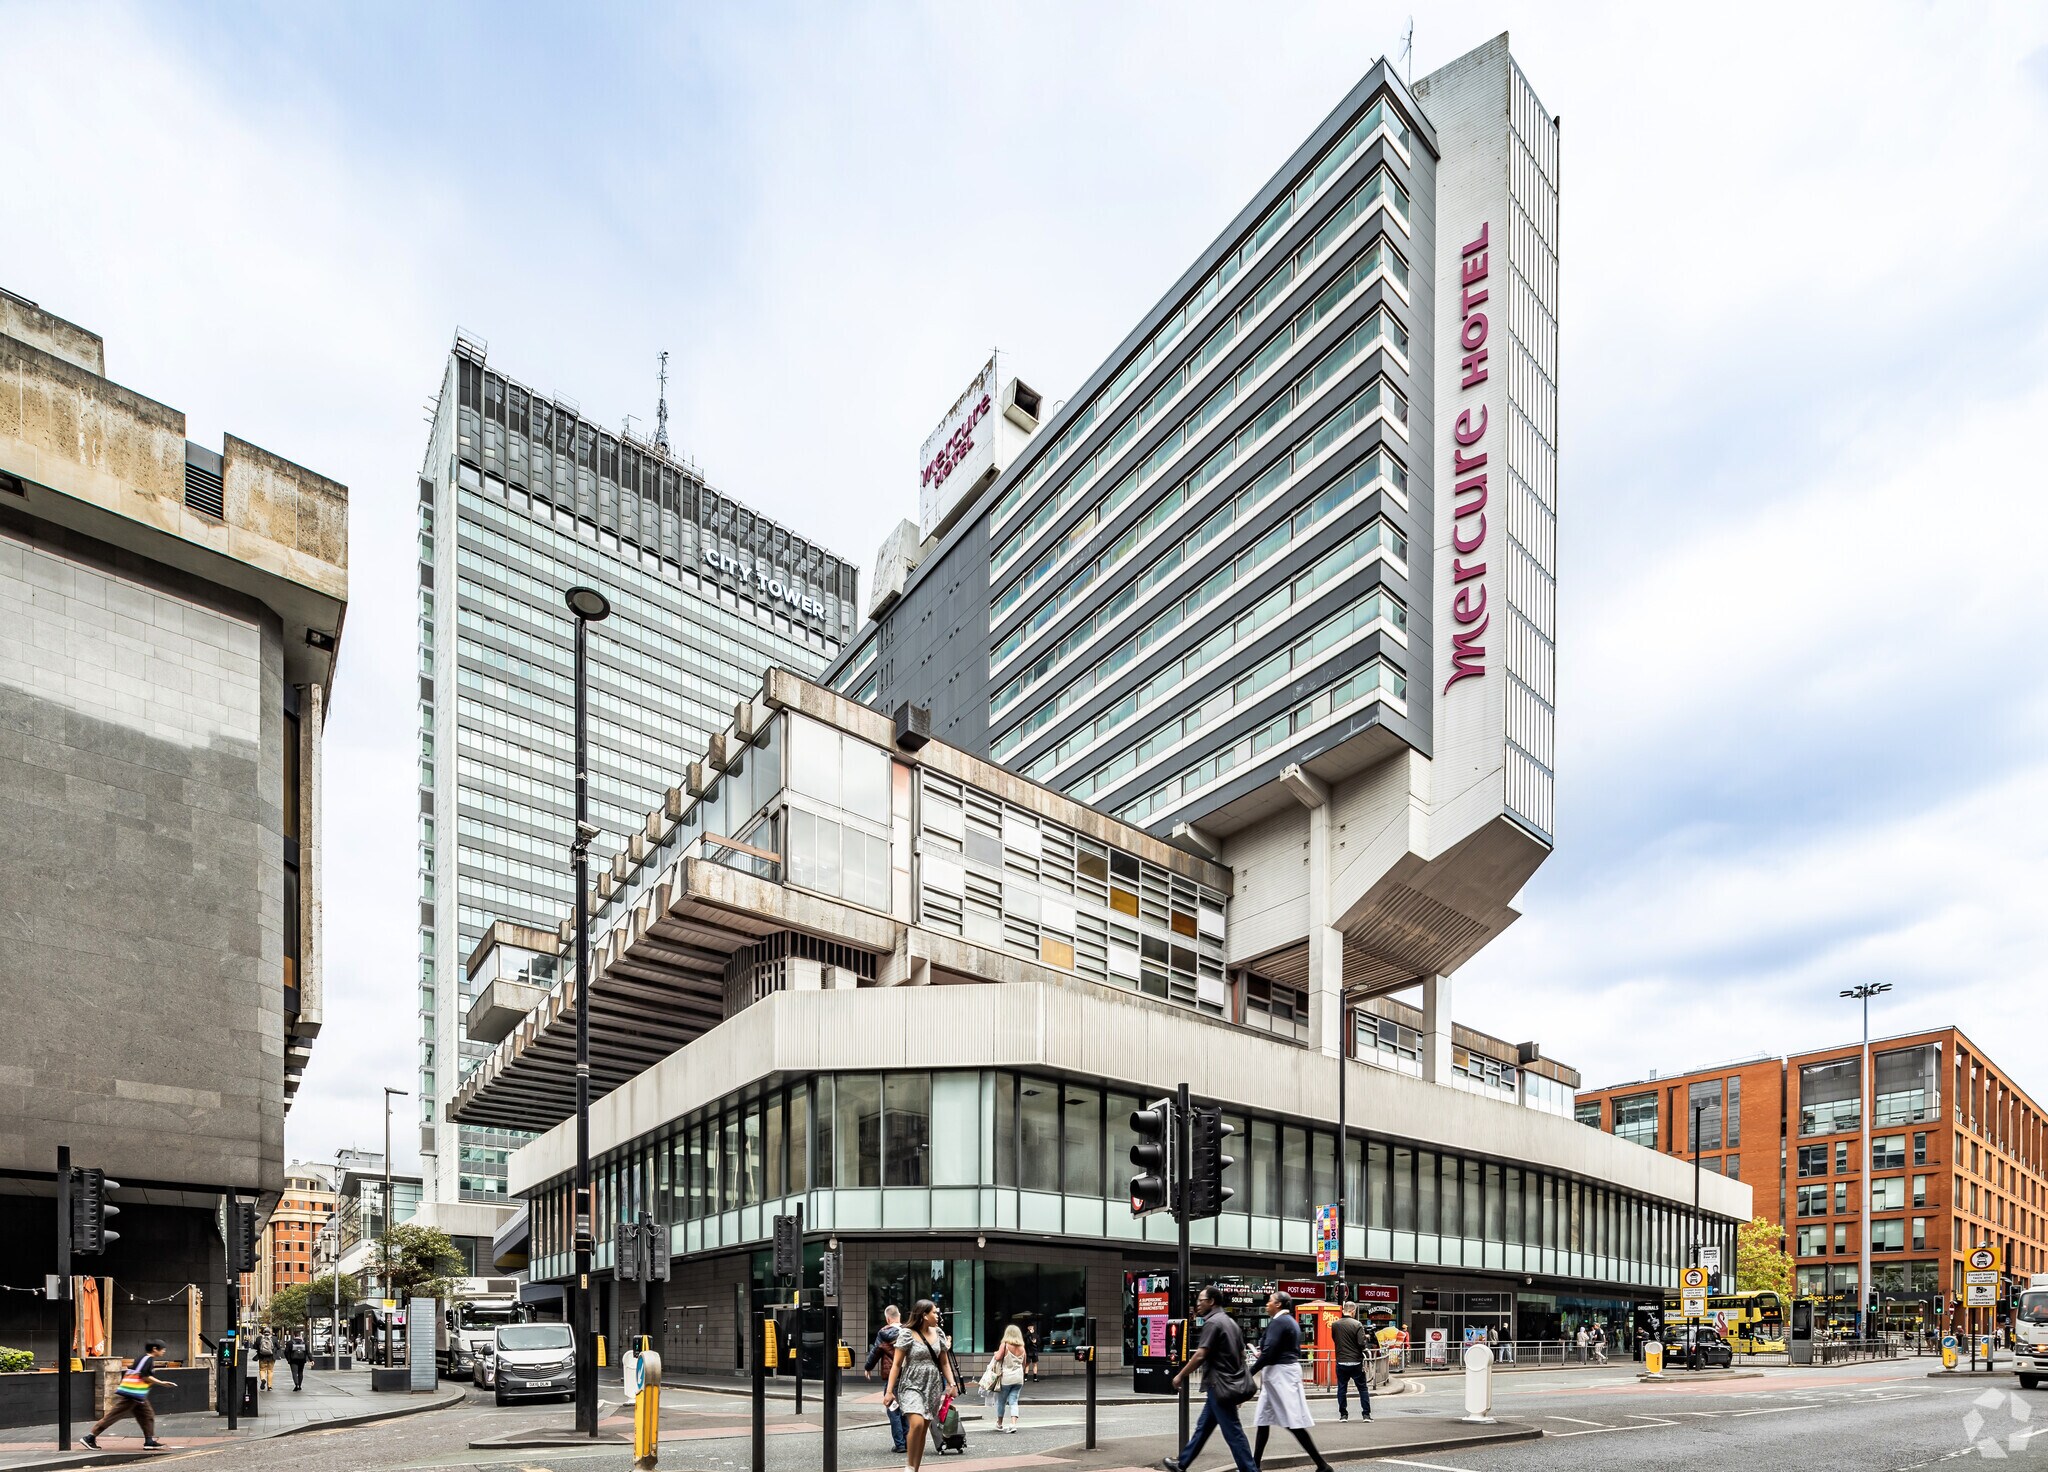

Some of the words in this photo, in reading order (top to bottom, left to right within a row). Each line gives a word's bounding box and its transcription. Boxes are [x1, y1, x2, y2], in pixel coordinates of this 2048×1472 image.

[1461, 221, 1489, 389] HOTEL
[705, 548, 752, 582] CITY
[756, 570, 827, 622] TOWER
[1368, 1306, 1393, 1315] MANCHESTER
